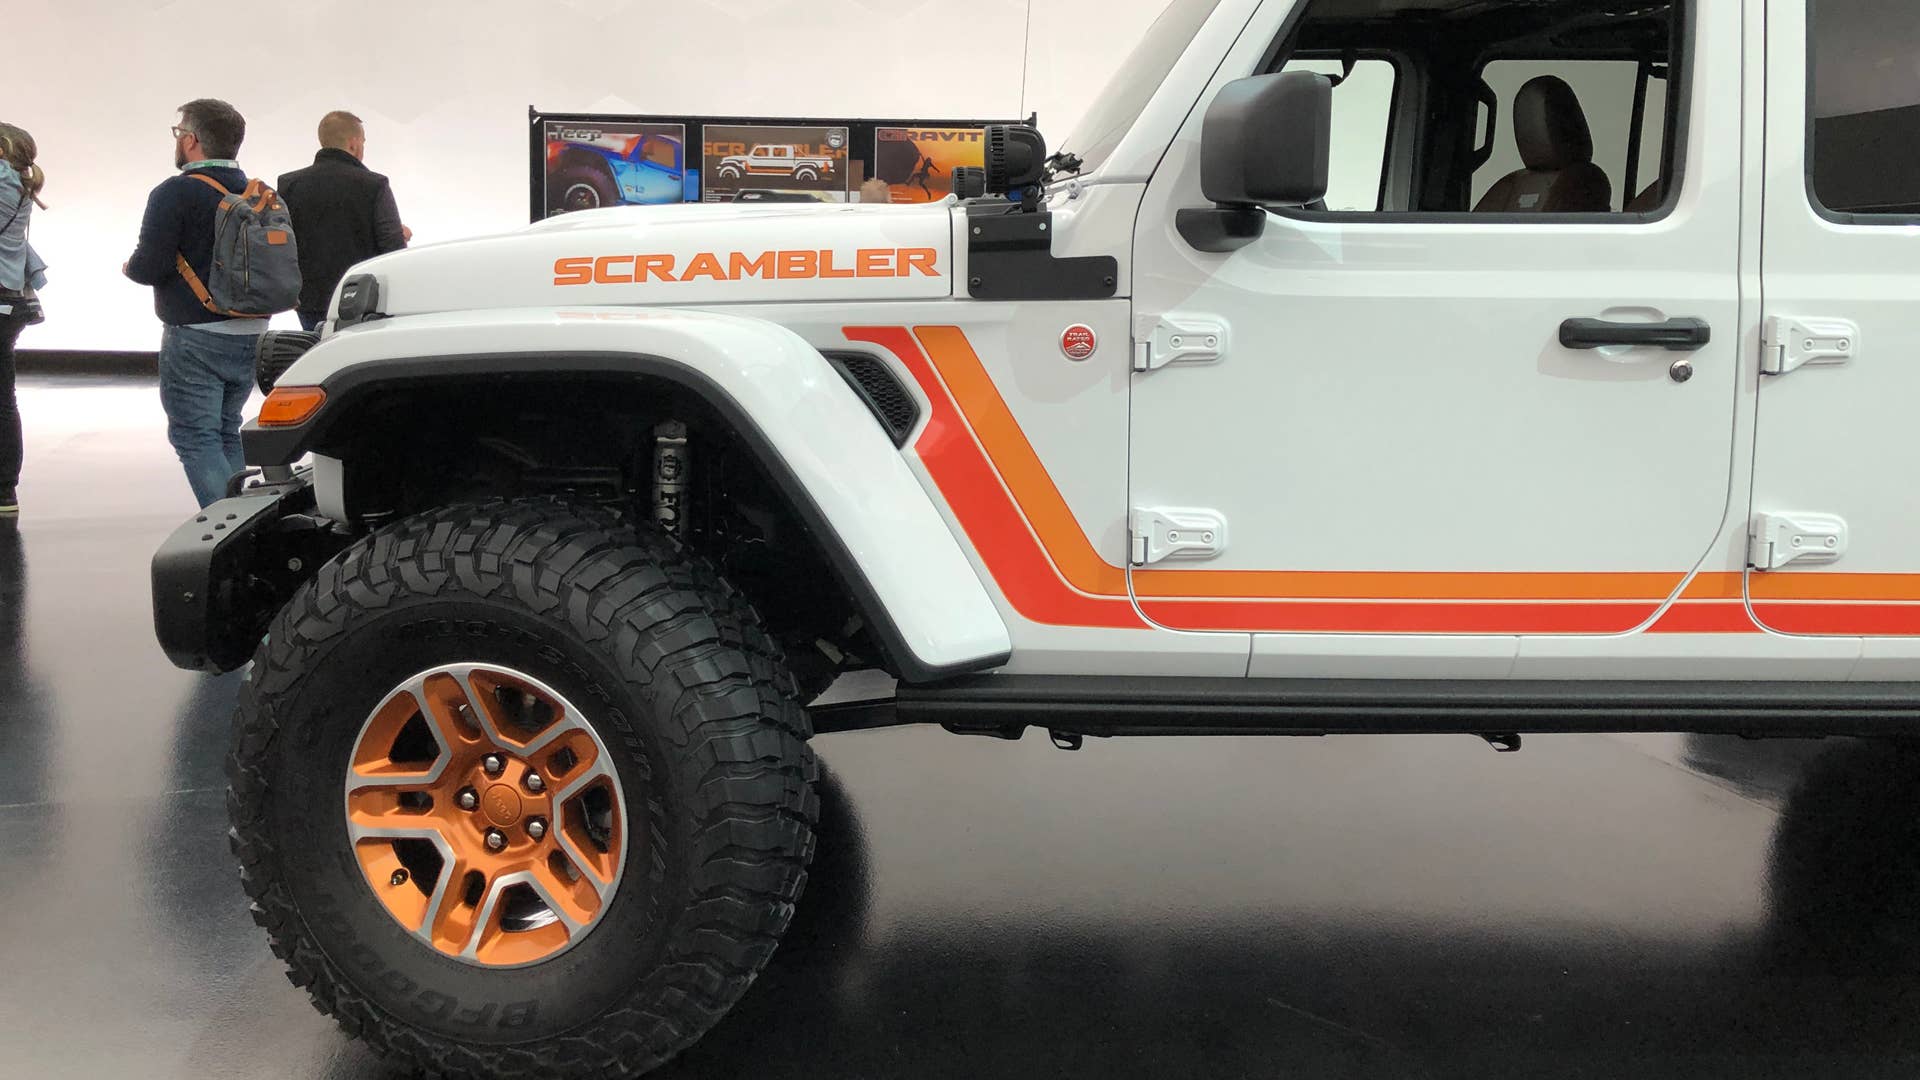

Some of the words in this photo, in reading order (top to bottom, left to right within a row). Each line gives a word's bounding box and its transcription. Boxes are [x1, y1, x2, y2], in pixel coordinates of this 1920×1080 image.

[547, 124, 602, 142] Jeep
[878, 129, 983, 143] GRAVIT
[553, 247, 942, 286] SCRAMBLER
